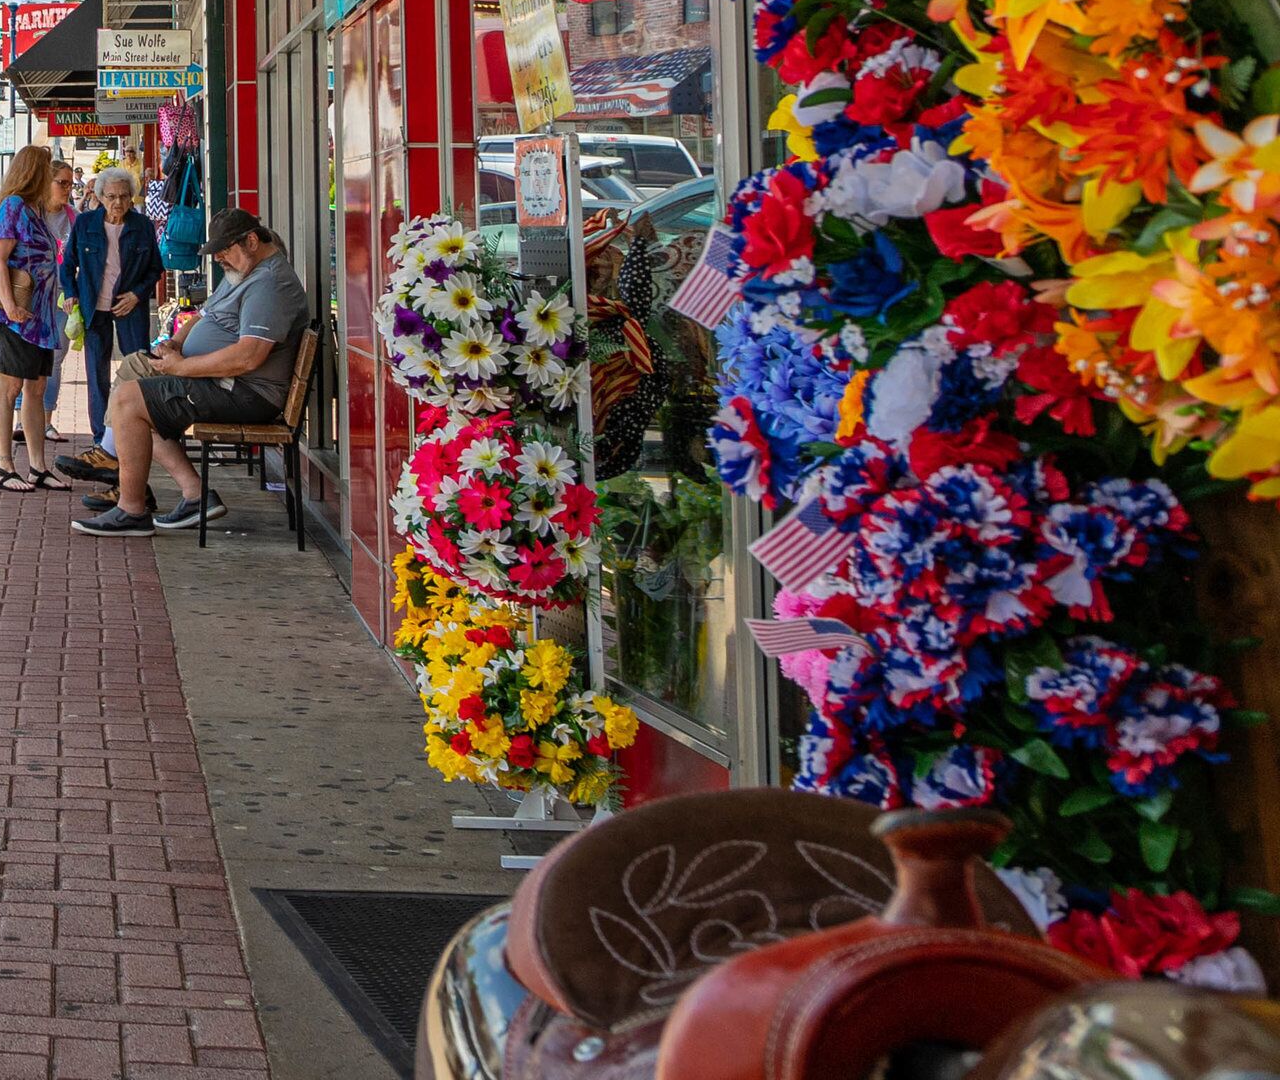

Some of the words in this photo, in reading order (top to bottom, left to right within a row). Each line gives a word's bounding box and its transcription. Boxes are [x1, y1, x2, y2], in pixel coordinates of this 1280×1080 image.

[114, 33, 134, 48] Sue
[138, 33, 166, 48] Wolfe
[102, 51, 122, 62] Main
[125, 51, 149, 63] Street
[151, 51, 181, 64] Jeweler
[101, 72, 169, 87] LEATHER
[526, 75, 558, 114] Inside
[125, 102, 157, 111] LEATHER
[56, 113, 81, 125] MAIN
[63, 124, 117, 136] MERCHANTS
